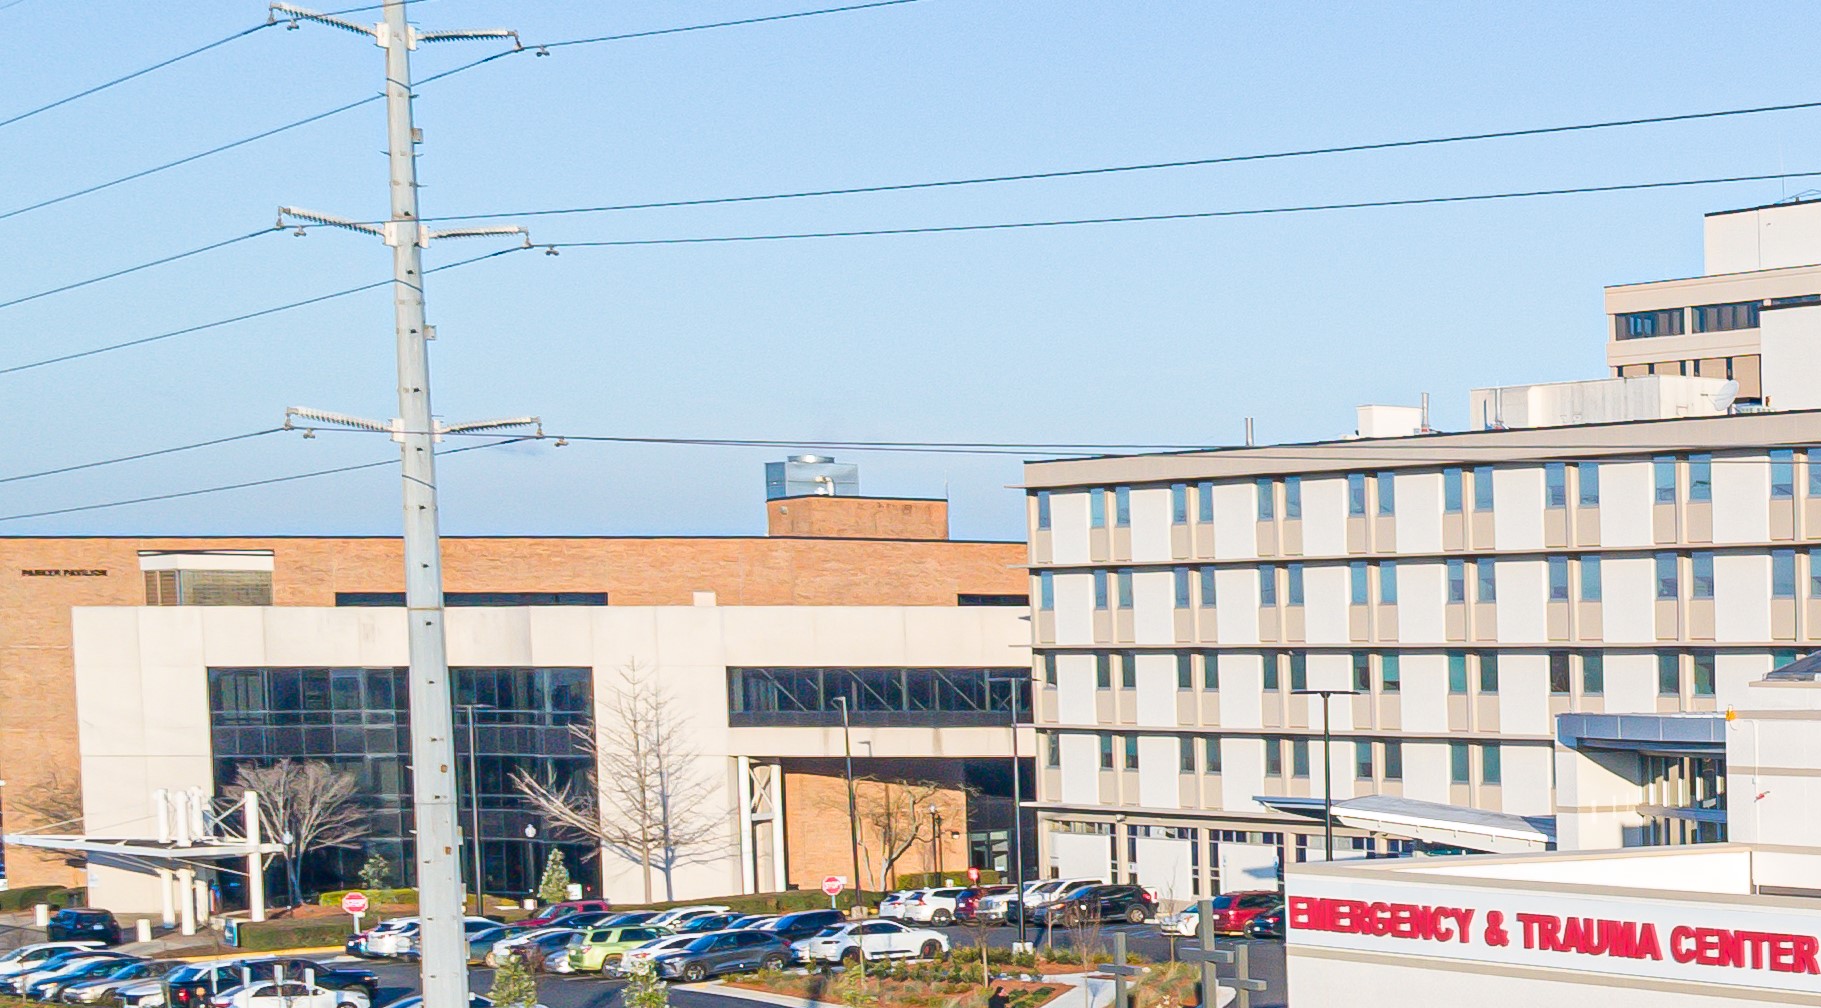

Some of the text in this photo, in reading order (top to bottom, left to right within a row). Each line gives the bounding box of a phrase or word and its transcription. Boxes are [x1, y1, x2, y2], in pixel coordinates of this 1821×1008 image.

[1288, 896, 1821, 975] EMERGENCY & TRAUMA CENTER
